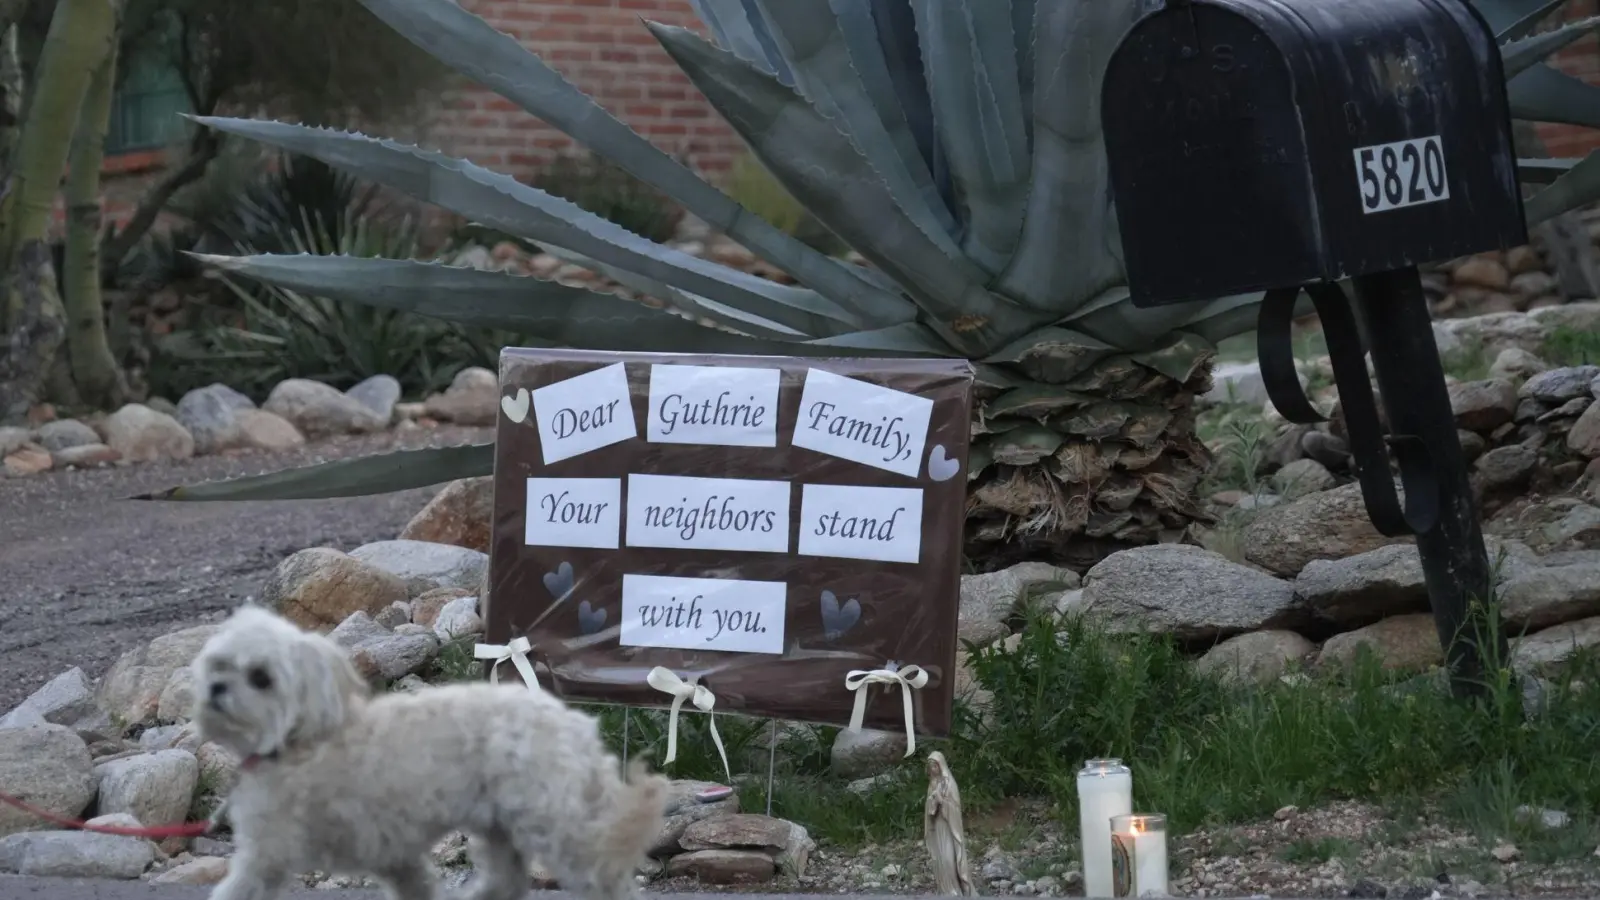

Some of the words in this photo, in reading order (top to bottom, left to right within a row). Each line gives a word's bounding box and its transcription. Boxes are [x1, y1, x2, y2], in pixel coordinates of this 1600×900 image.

[1361, 139, 1444, 209] 5820
[552, 398, 619, 440] Dear
[659, 391, 765, 435] Guthrie
[809, 401, 913, 462] Family,
[541, 491, 608, 524] Your
[644, 496, 776, 540] neighbors
[815, 507, 906, 542] stand
[639, 595, 703, 630] with
[706, 609, 767, 642] you.
